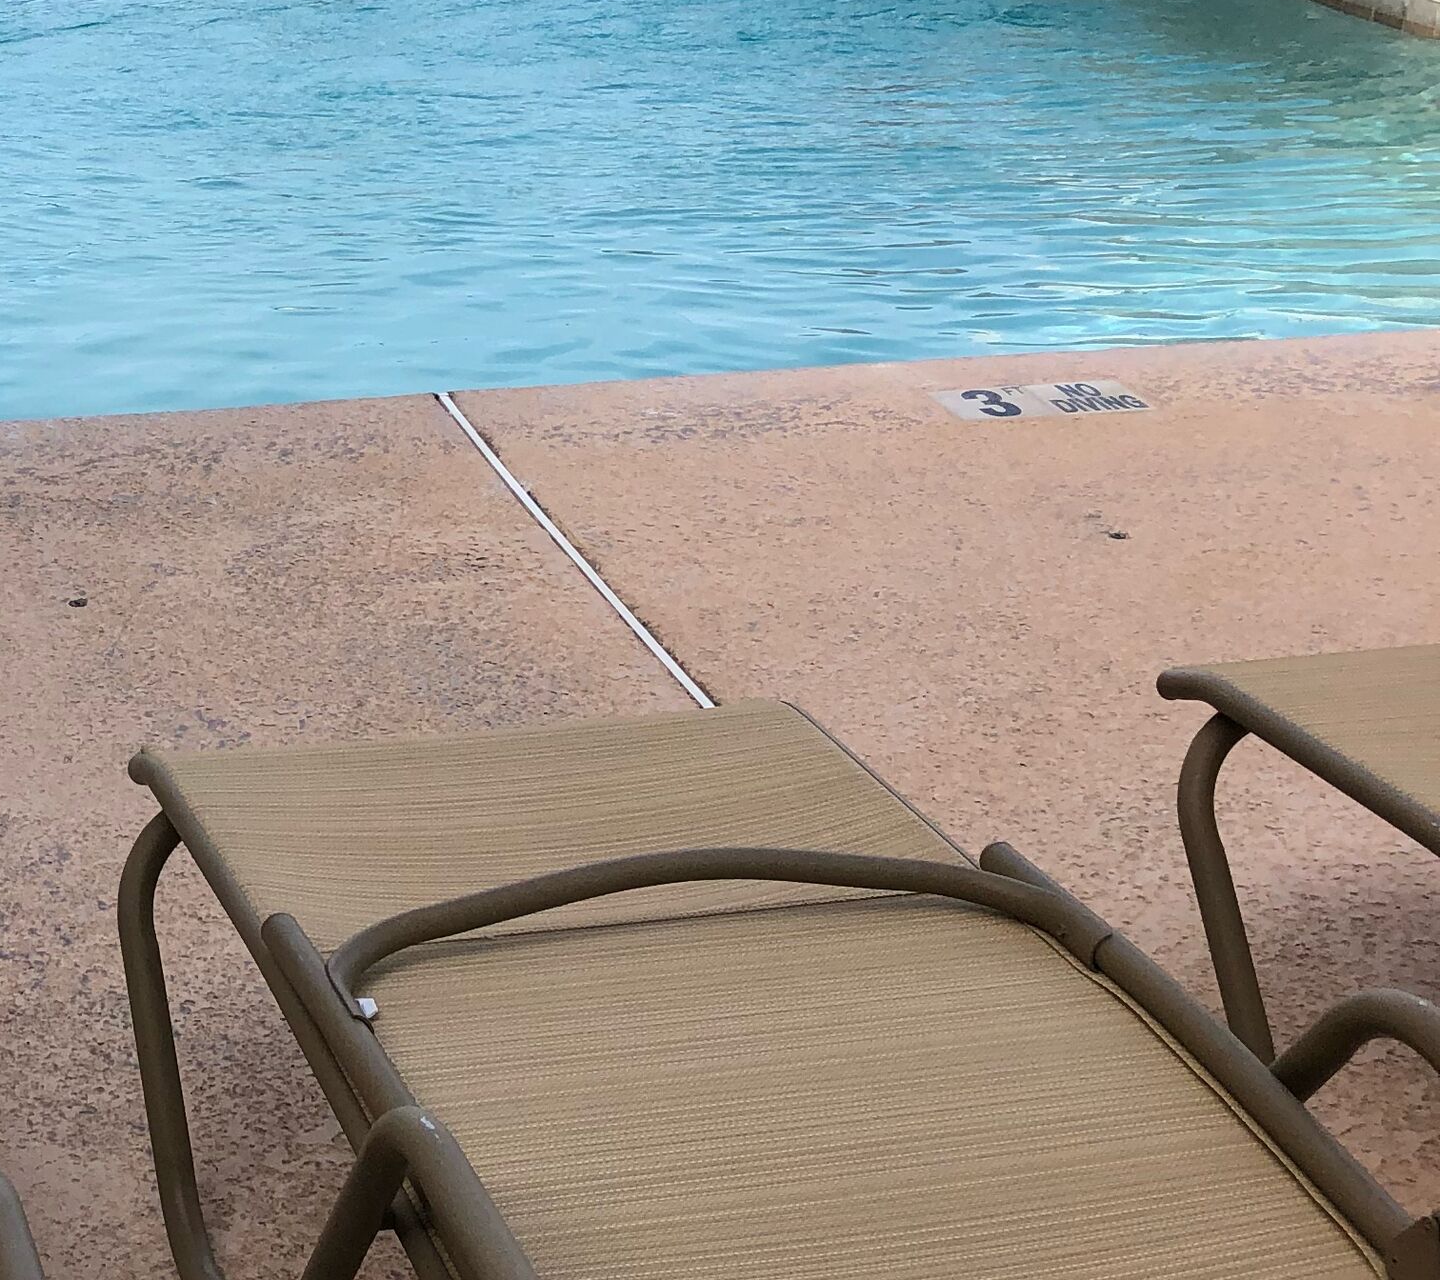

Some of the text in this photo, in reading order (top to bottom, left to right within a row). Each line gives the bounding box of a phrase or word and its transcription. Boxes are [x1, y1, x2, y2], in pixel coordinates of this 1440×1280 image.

[1054, 383, 1102, 397] NO
[961, 386, 1025, 417] 3 FT
[1049, 395, 1149, 413] DIVING
